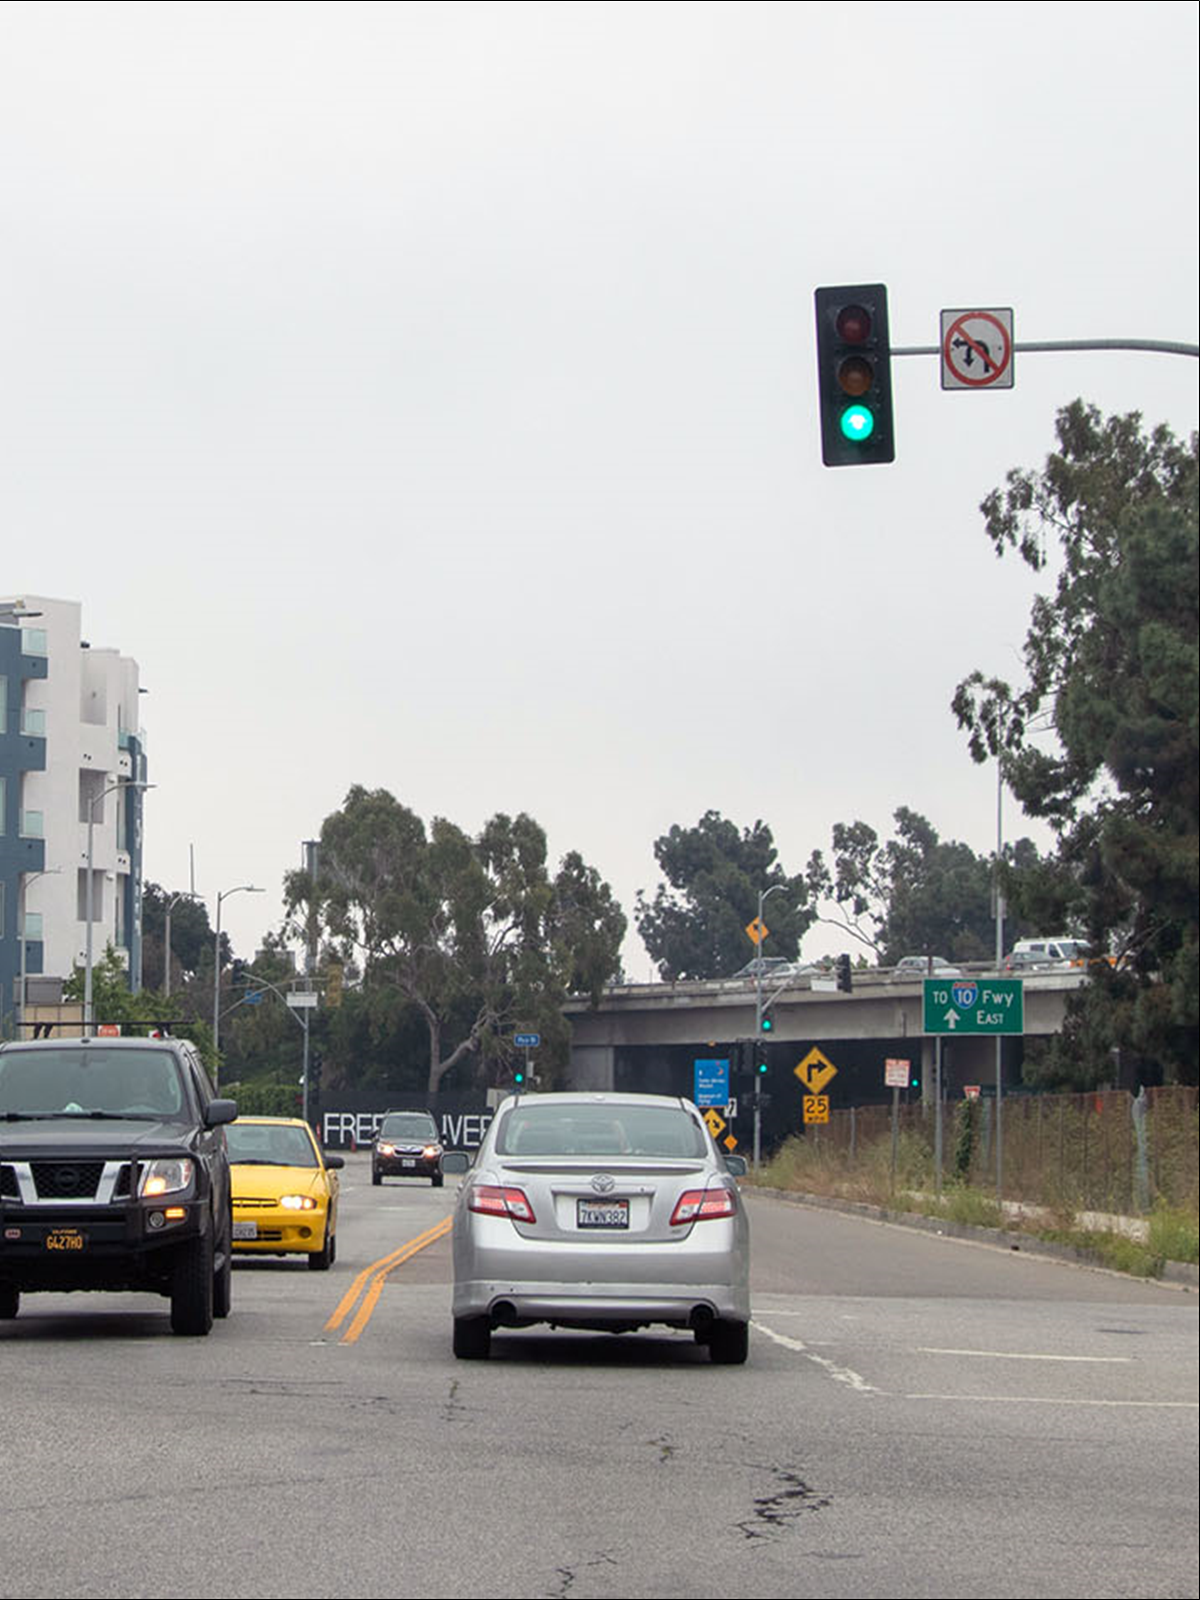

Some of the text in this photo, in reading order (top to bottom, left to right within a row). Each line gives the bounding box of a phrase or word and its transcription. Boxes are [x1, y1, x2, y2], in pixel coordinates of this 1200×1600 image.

[933, 989, 1014, 1008] TO 10 Fwy
[976, 1010, 1004, 1025] EAST
[806, 1098, 827, 1114] 25
